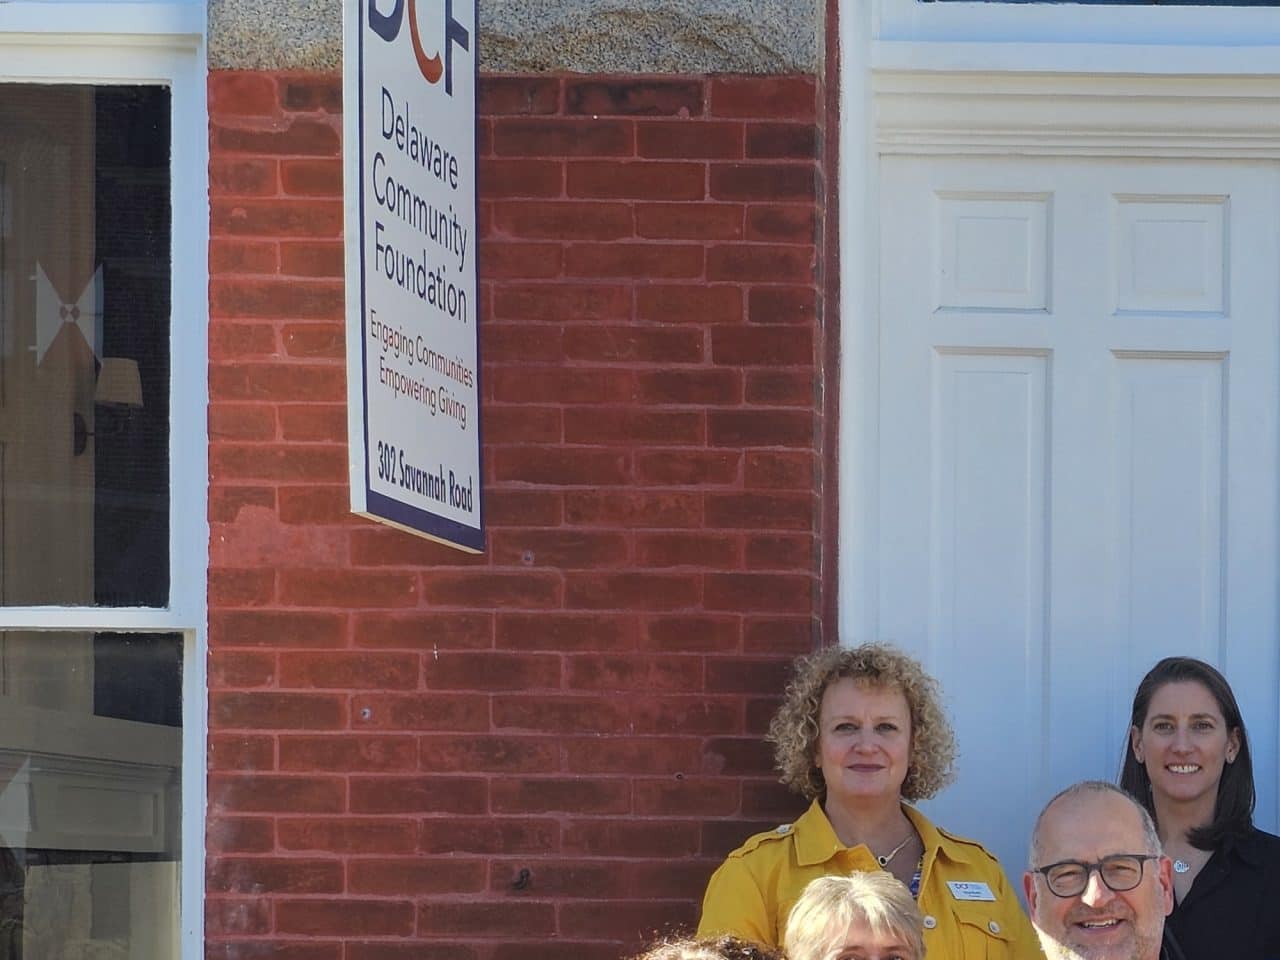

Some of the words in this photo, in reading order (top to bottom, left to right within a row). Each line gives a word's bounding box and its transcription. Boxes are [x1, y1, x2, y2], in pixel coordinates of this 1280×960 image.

[381, 86, 458, 190] Delaware
[373, 152, 467, 272] Community
[375, 220, 467, 323] Foundation
[370, 309, 414, 366] Engaging
[416, 335, 473, 388] Communities
[379, 356, 436, 416] Empowering
[438, 385, 466, 430] Giving
[378, 440, 396, 484] 302
[400, 449, 446, 503] Savannah
[449, 469, 472, 513] Road
